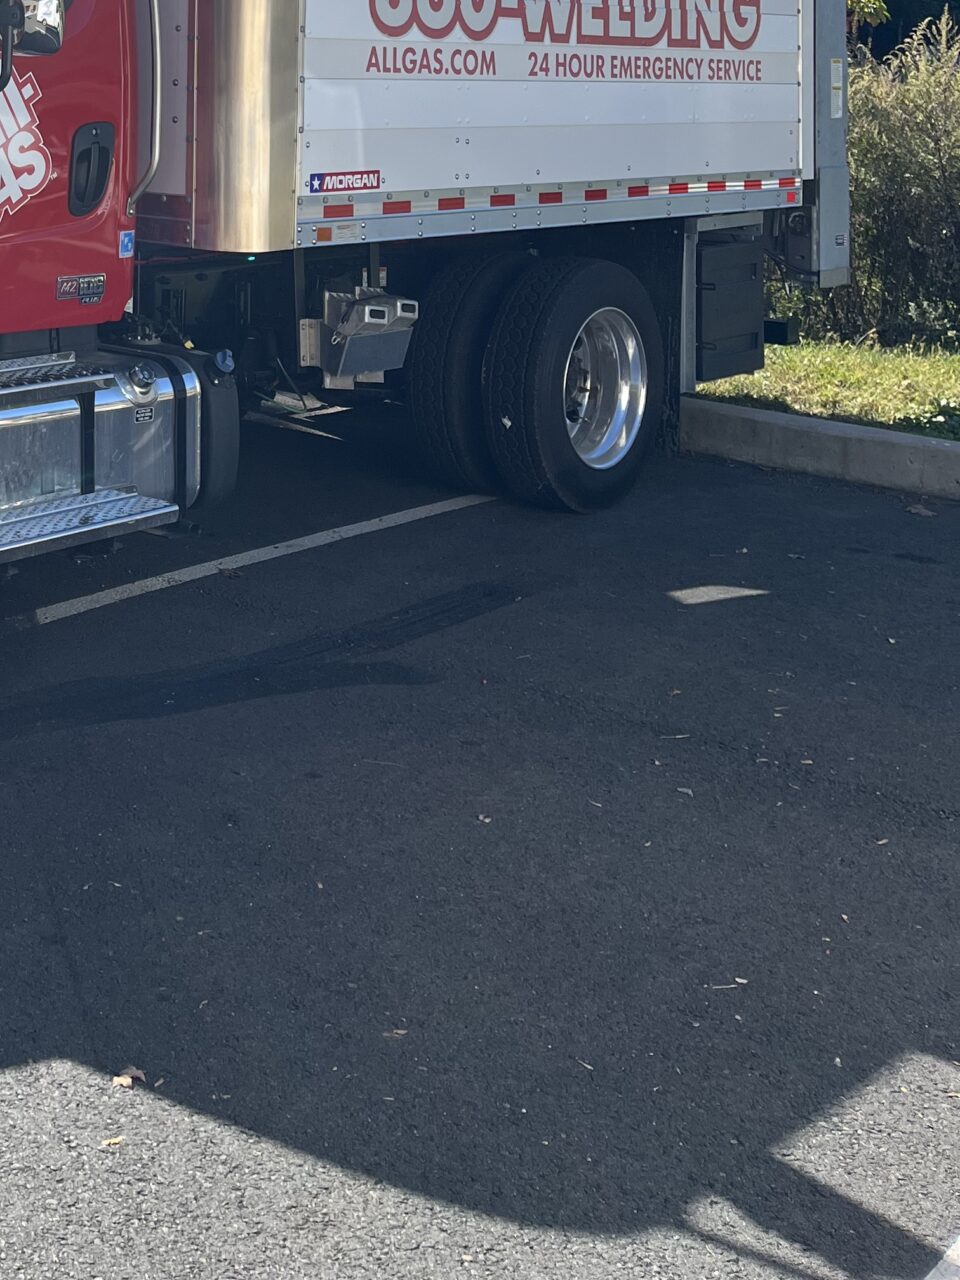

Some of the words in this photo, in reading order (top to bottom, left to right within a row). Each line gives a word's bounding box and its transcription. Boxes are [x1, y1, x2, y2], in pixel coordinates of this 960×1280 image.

[365, 46, 497, 76] ALLGAS.COM
[527, 51, 550, 77] 24
[555, 53, 605, 79] HOUR
[610, 55, 704, 81] EMERGENCY
[707, 58, 762, 81] SERVICE
[323, 173, 379, 190] MORGAN
